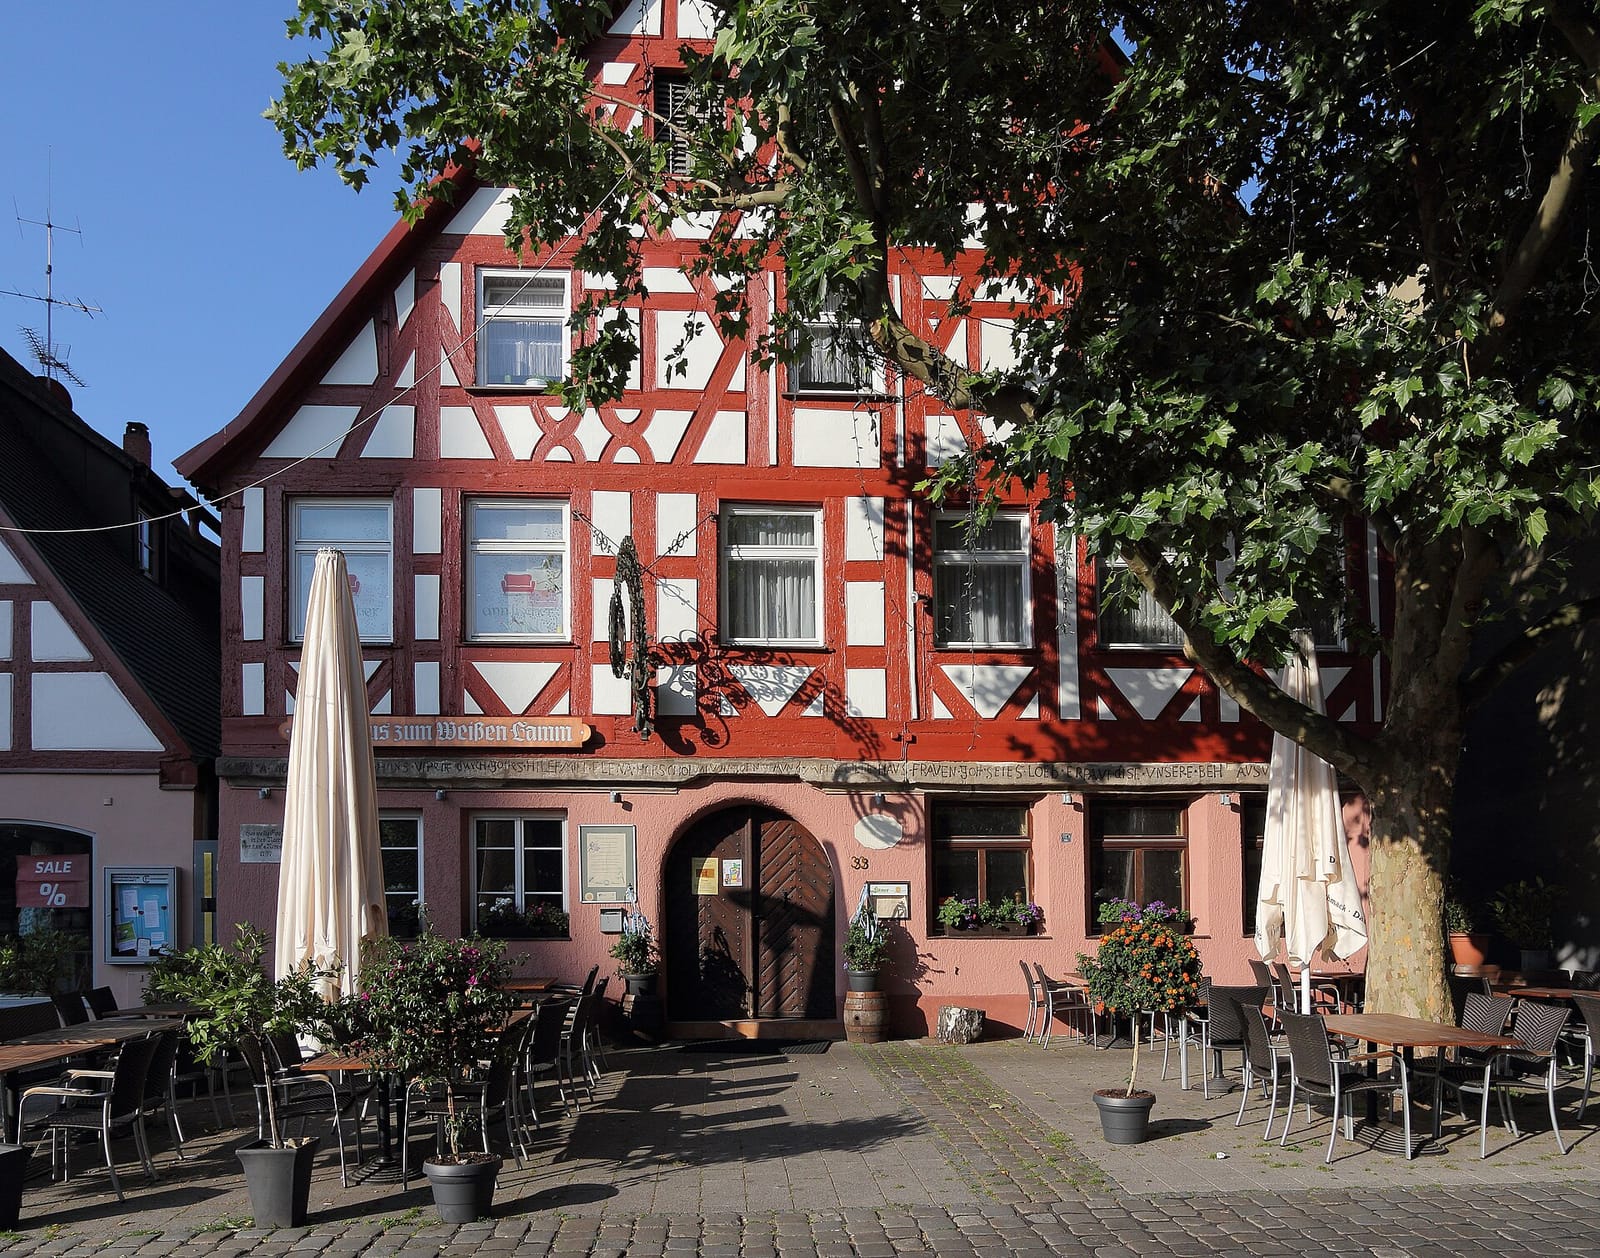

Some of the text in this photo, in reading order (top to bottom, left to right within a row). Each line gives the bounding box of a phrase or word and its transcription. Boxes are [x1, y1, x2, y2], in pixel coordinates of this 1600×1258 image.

[393, 720, 433, 742] zum
[436, 720, 509, 742] Weißen
[511, 720, 573, 742] Lamm
[35, 861, 73, 874] SALE
[851, 856, 869, 870] 33
